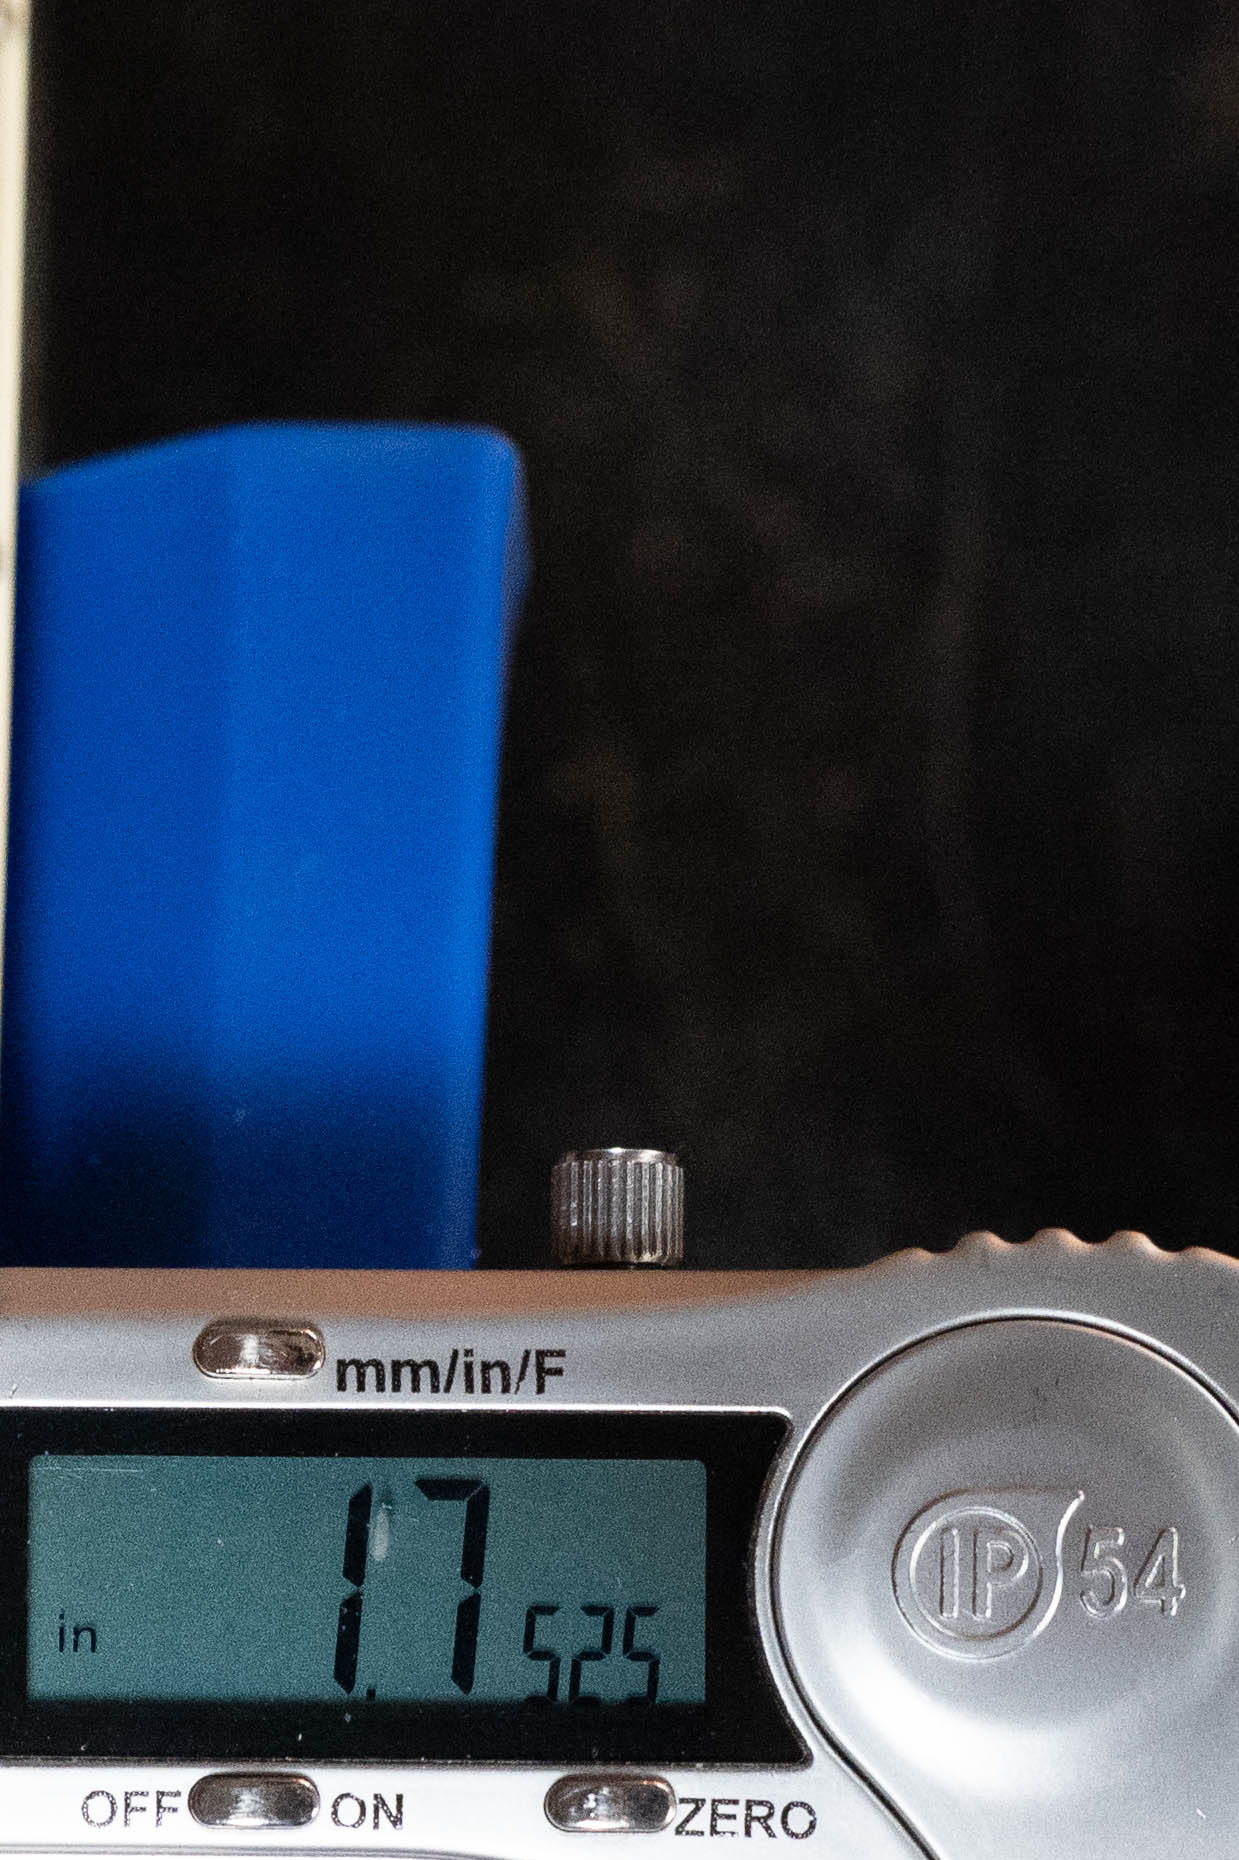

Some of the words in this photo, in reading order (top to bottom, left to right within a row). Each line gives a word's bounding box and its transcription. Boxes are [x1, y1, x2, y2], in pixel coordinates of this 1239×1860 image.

[336, 1348, 567, 1396] mm/in/F
[1079, 1525, 1187, 1620] 54
[57, 1608, 98, 1654] in
[80, 1790, 183, 1828] OFF
[330, 1791, 405, 1831] ON
[674, 1797, 819, 1841] ZERO
